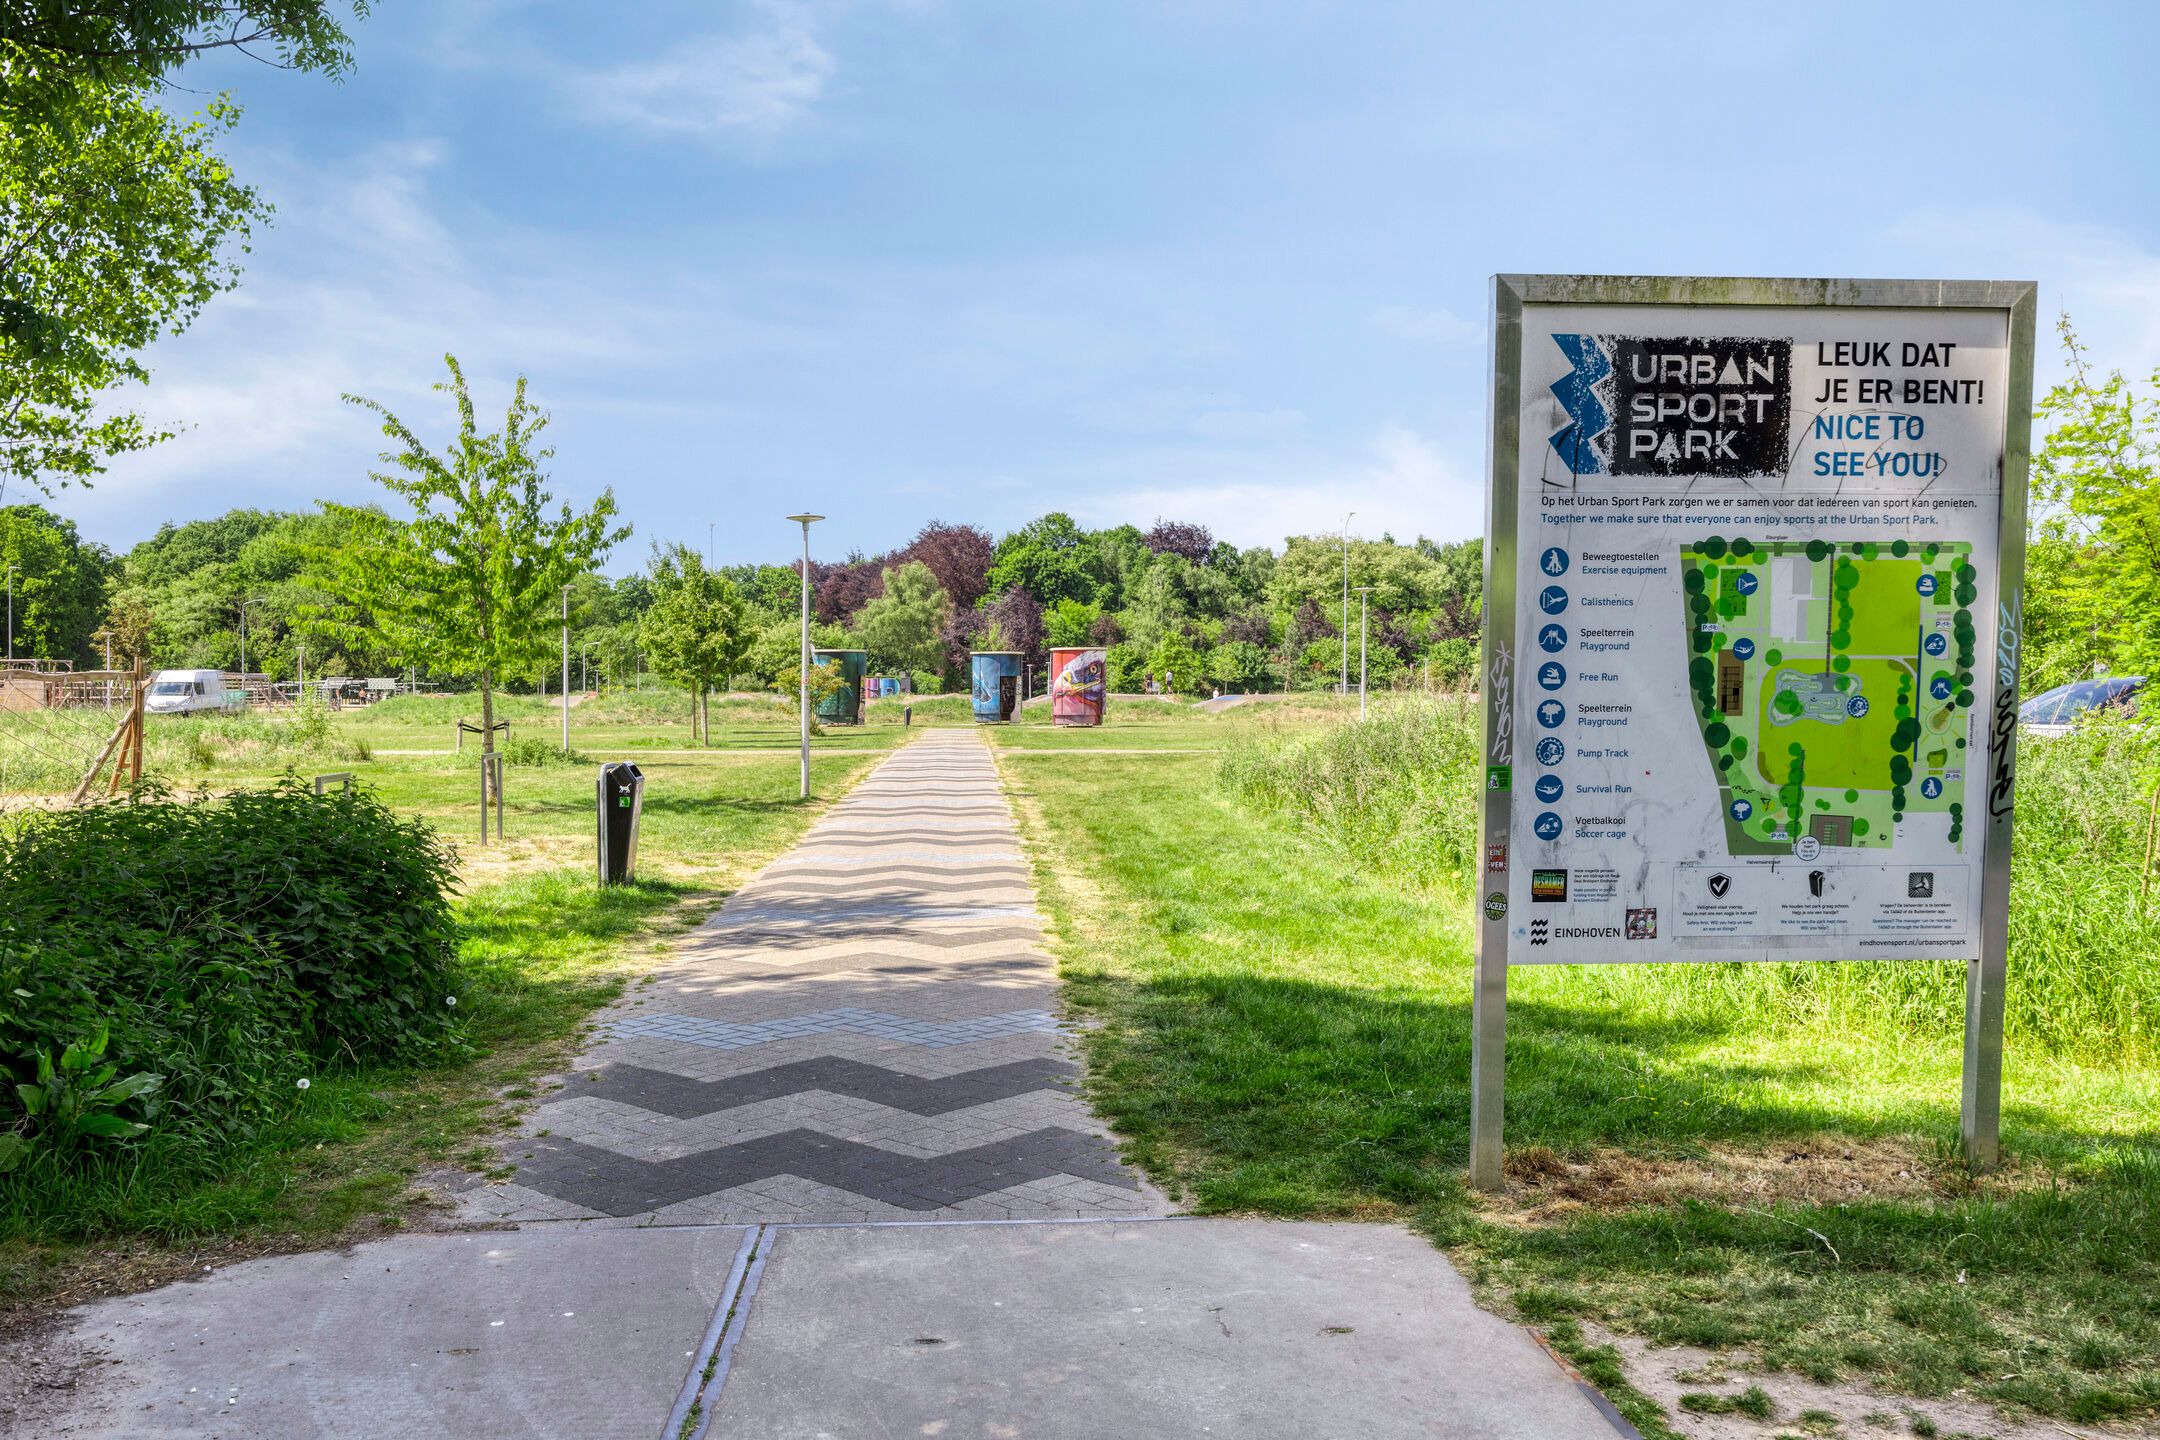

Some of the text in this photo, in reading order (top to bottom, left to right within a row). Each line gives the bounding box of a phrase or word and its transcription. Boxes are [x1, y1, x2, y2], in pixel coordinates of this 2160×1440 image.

[1818, 342, 1956, 367] LEUK DAT
[1631, 354, 1774, 385] URBAN
[1815, 379, 1983, 404] JE ER BENT!
[1630, 394, 1774, 424] SPORT
[1815, 415, 1924, 440] NICE TO
[1630, 430, 1739, 460] PARK
[1814, 452, 1939, 477] SEE YOU!
[1541, 495, 1555, 508] Op
[1558, 495, 1575, 506] het
[1578, 496, 1608, 506] Urban
[1612, 496, 1639, 508] Sport
[1643, 497, 1665, 506] Park
[1669, 496, 1702, 508] zorgen
[1798, 498, 1813, 506] dat
[1817, 496, 1859, 507] iedereen
[1884, 499, 1908, 509] sport
[1912, 497, 1929, 507] kan
[1933, 498, 1977, 510] genieten.
[1541, 514, 1587, 526] Together
[1589, 515, 1604, 524] we
[1607, 513, 1634, 523] make
[1637, 514, 1659, 523] sure
[1662, 514, 1682, 523] that
[1685, 516, 1731, 525] everyone
[1754, 514, 1780, 526] enjoy
[1784, 515, 1815, 526] sports
[1818, 516, 1827, 524] at
[1831, 515, 1846, 524] the
[1850, 515, 1879, 524] Urban
[1883, 515, 1909, 526] Sport
[1913, 515, 1938, 524] Park.
[1583, 552, 1659, 562] Beweegtoestellen
[1582, 566, 1666, 576] Exercise equipment
[1581, 598, 1633, 606] Calisthenics
[1581, 629, 1634, 638] Speelterrein
[1580, 642, 1629, 652] Playground
[1580, 673, 1618, 681] Free Run
[1579, 704, 1631, 714] Speelterrein
[1578, 718, 1627, 727] Playground
[1578, 749, 1628, 759] Pump Track
[1577, 785, 1632, 793] Survival Run
[1576, 817, 1625, 826] Voetbalkooi
[1575, 829, 1604, 838] Soccer
[1555, 928, 1620, 937] EINDHOVEN
